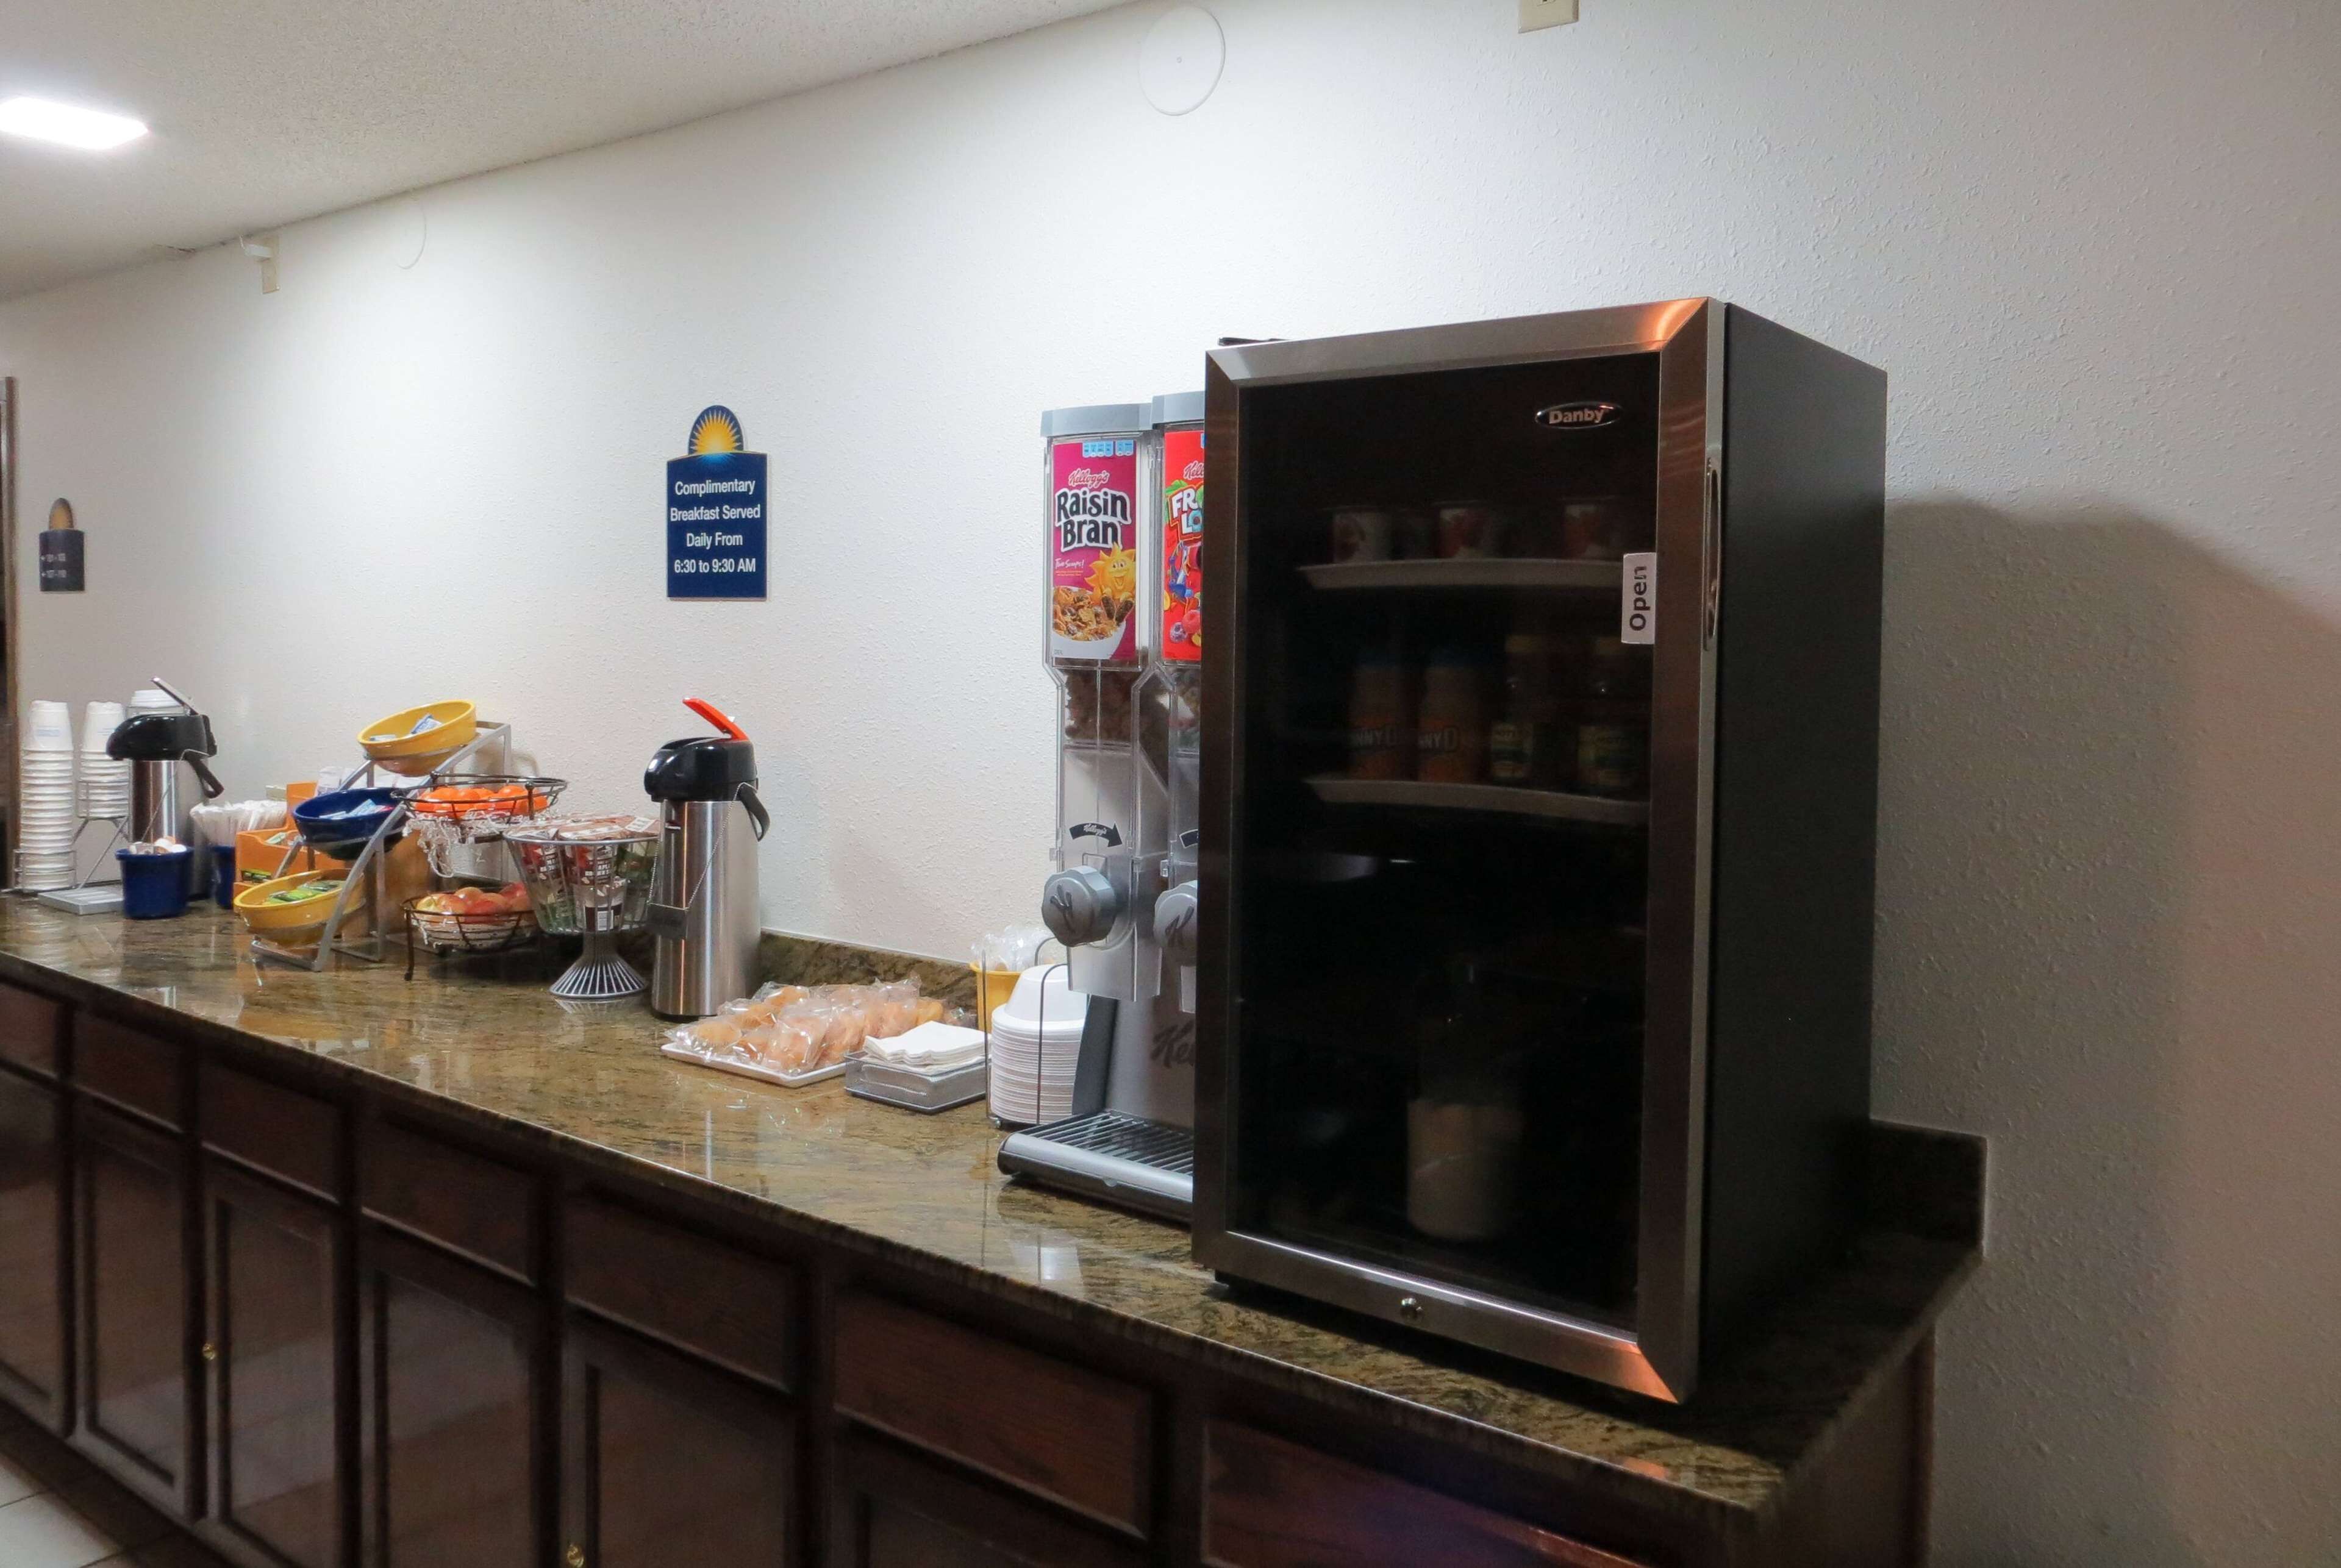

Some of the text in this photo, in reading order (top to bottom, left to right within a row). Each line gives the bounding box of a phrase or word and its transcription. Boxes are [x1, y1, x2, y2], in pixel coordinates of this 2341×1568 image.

[1549, 407, 1605, 425] Danby
[1068, 468, 1110, 488] Kellogg's
[675, 479, 756, 497] Complimentary
[670, 504, 760, 521] Breakfast Served
[1056, 490, 1129, 523] Raisin
[686, 532, 743, 549] Daily From
[1062, 519, 1119, 549] Bran
[674, 558, 756, 573] 6:30 to 9:30 AM
[1629, 565, 1651, 632] Open
